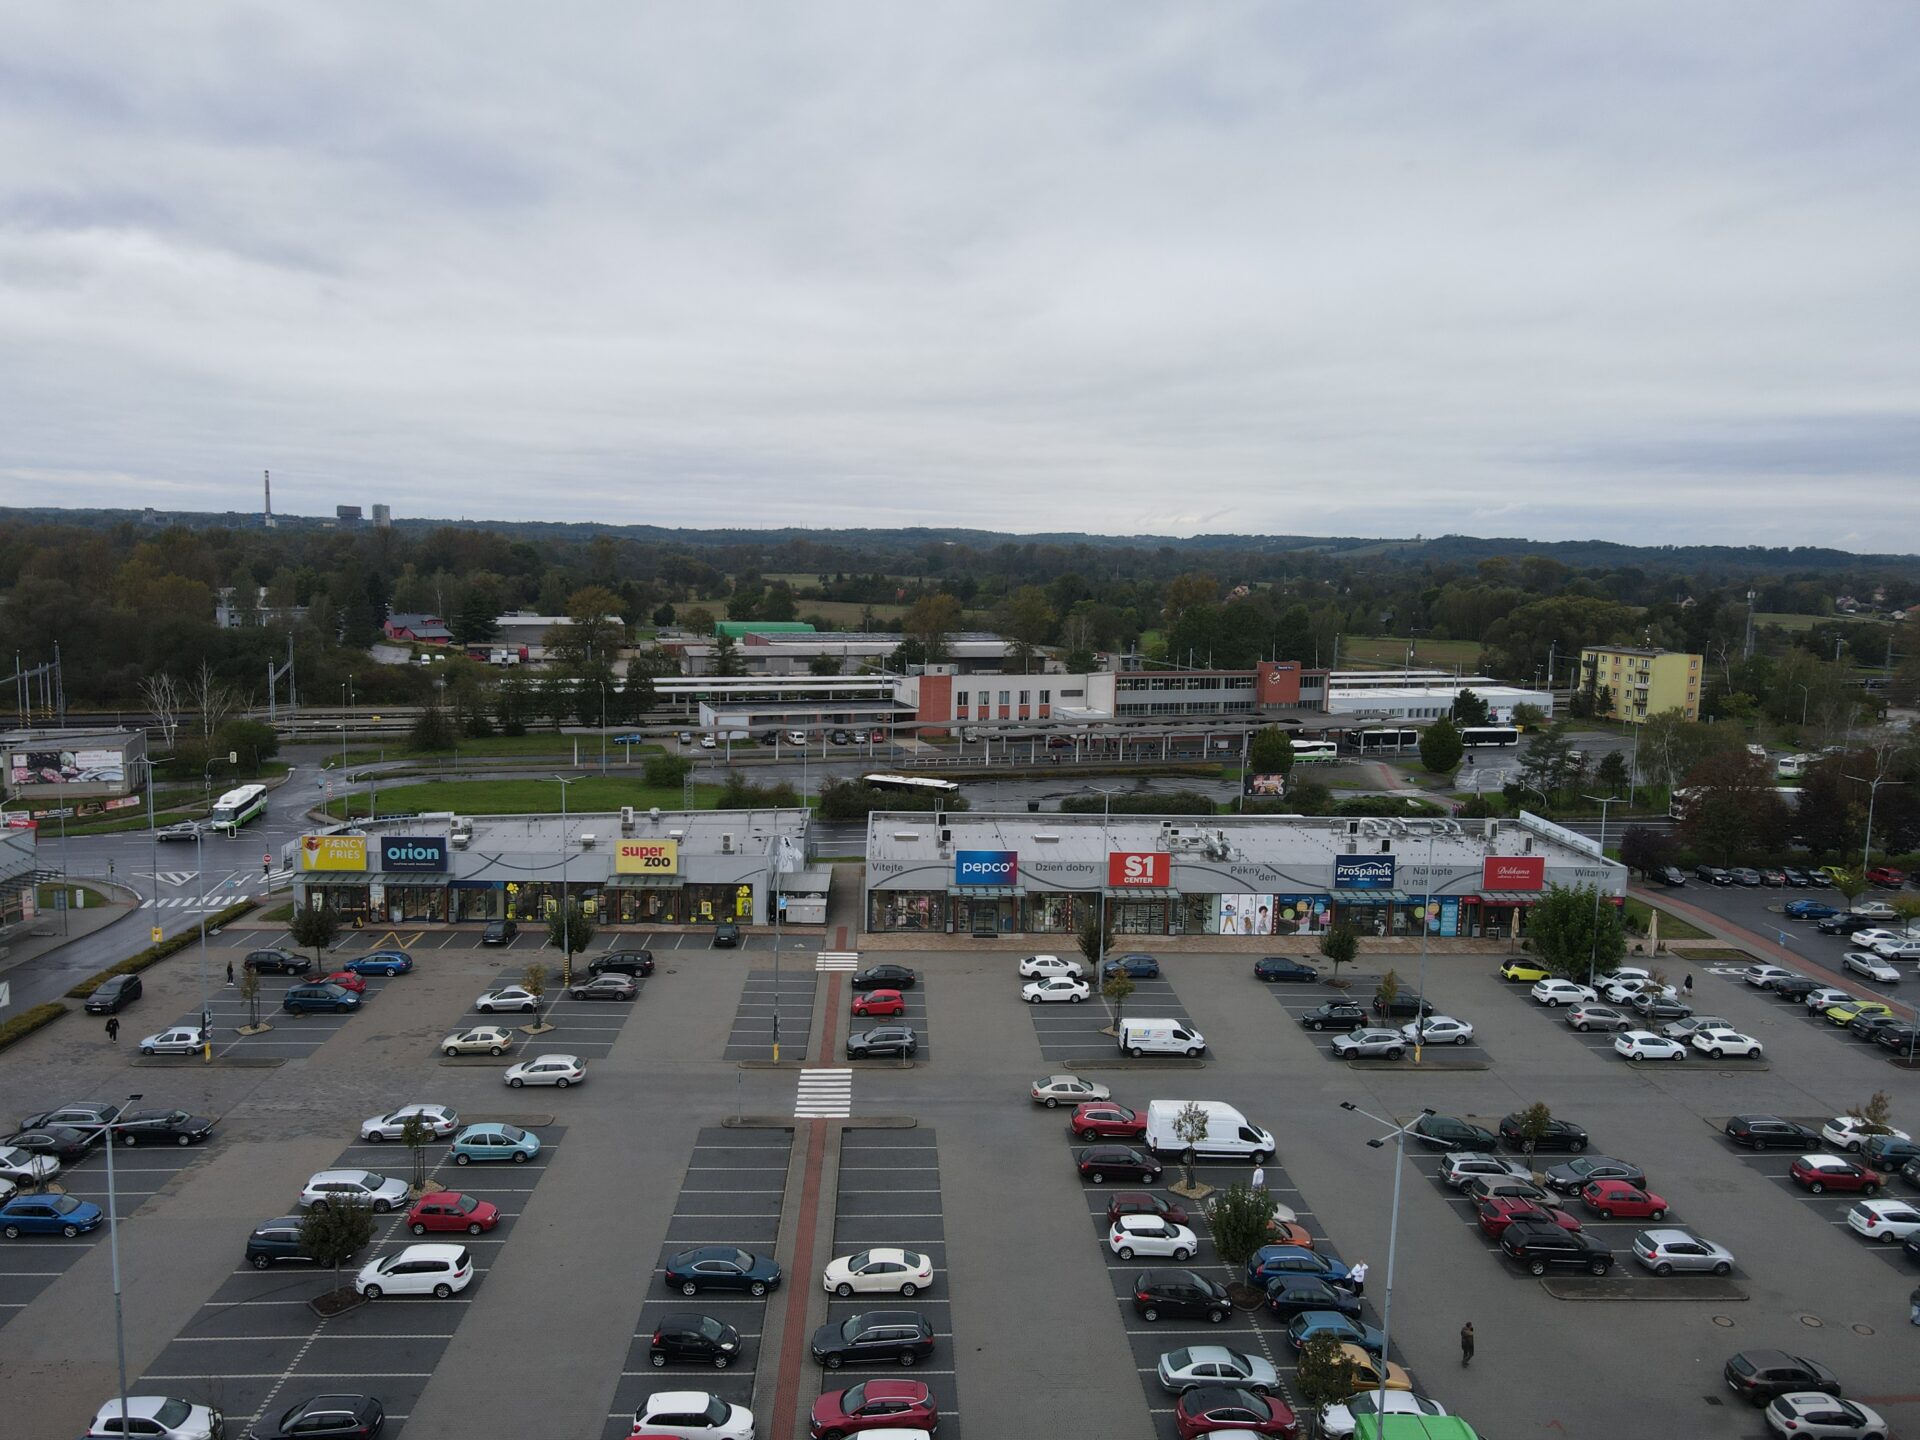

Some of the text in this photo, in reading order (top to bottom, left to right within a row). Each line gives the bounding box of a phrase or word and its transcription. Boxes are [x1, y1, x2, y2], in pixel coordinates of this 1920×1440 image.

[324, 840, 364, 848] FÆNCY
[329, 850, 360, 859] FRIES
[387, 842, 439, 860] orion
[621, 846, 665, 860] super
[643, 857, 671, 867] zoo
[1124, 855, 1154, 877] S1
[962, 862, 1010, 875] pepco
[1066, 863, 1095, 874] dobry
[1337, 866, 1392, 877] ProSpánek
[1575, 868, 1610, 879] Witamy
[1123, 876, 1153, 884] CENTER
[1258, 872, 1277, 881] den
